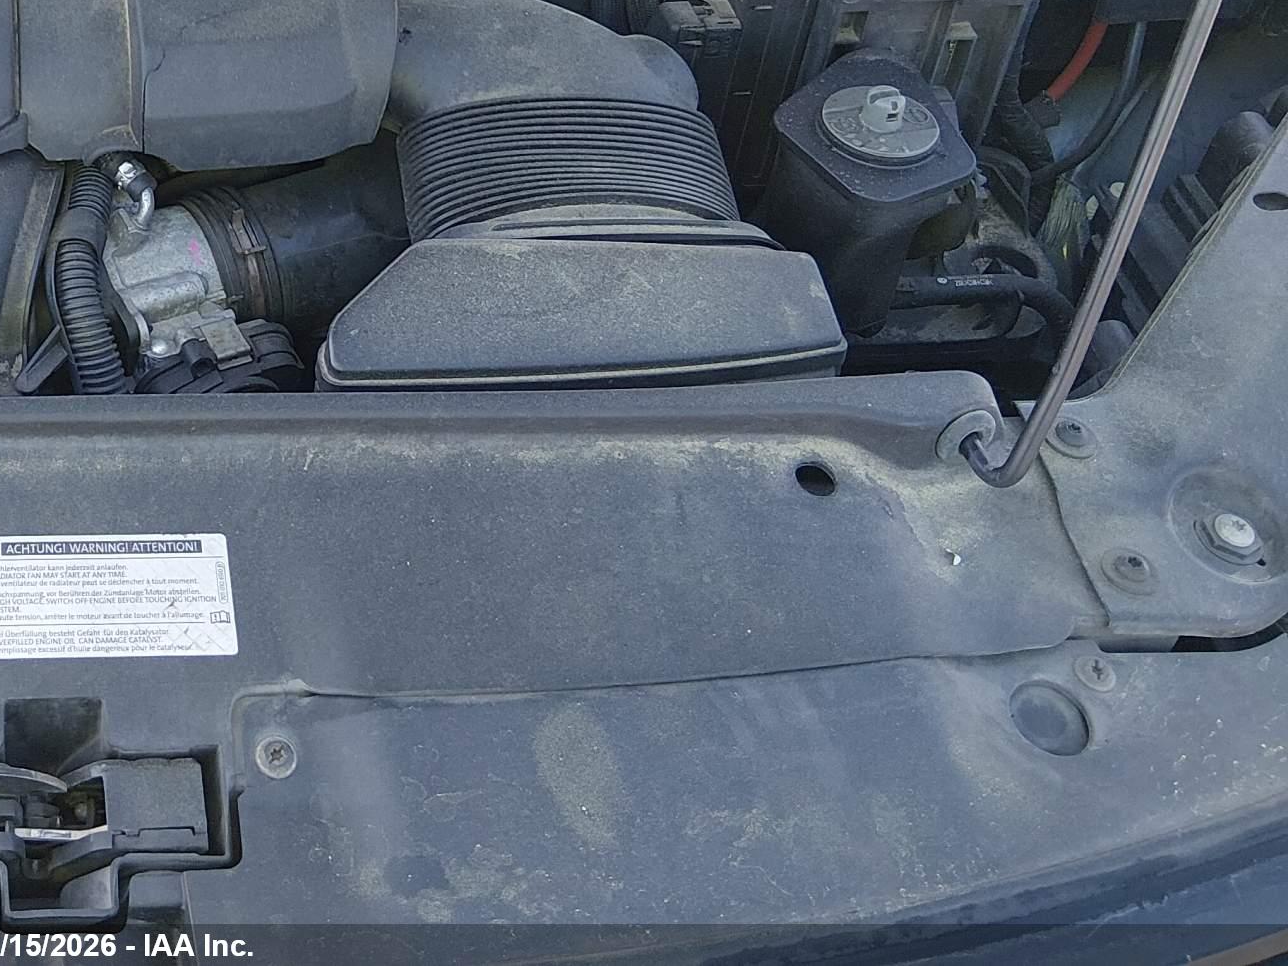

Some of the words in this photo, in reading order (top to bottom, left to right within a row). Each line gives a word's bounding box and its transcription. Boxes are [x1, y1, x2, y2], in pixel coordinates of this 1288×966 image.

[6, 543, 66, 554] ACHTUNG!
[69, 542, 129, 553] WARNING!
[131, 541, 197, 552] ATTENTION!
